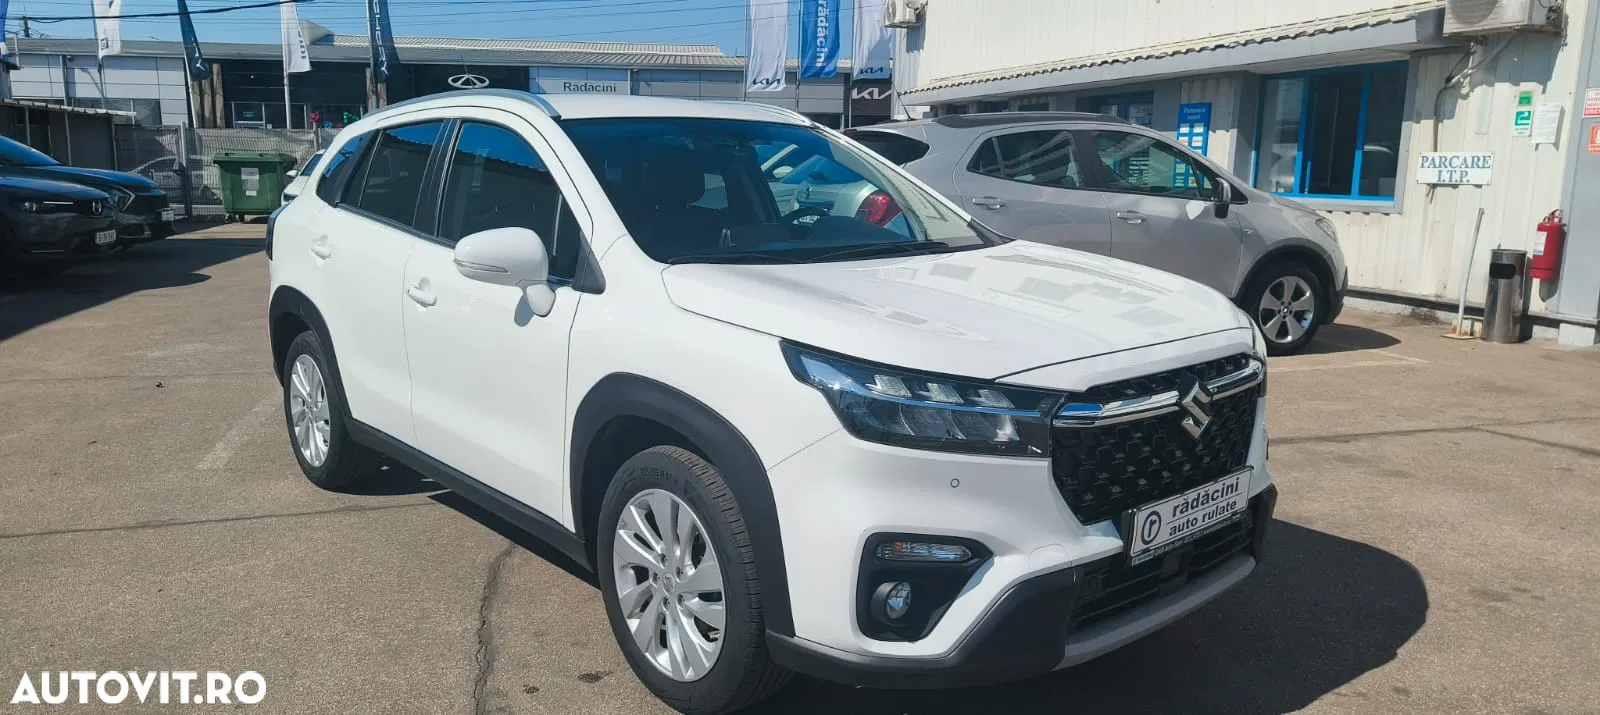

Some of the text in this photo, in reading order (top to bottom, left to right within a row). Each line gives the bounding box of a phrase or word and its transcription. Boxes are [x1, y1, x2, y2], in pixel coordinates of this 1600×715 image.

[563, 81, 616, 93] Radacini
[1420, 155, 1492, 169] PARCARE
[1436, 170, 1470, 183] I.T.P.
[1172, 478, 1240, 518] rădăcini
[1169, 516, 1199, 536] auto
[1202, 500, 1237, 523] rulate
